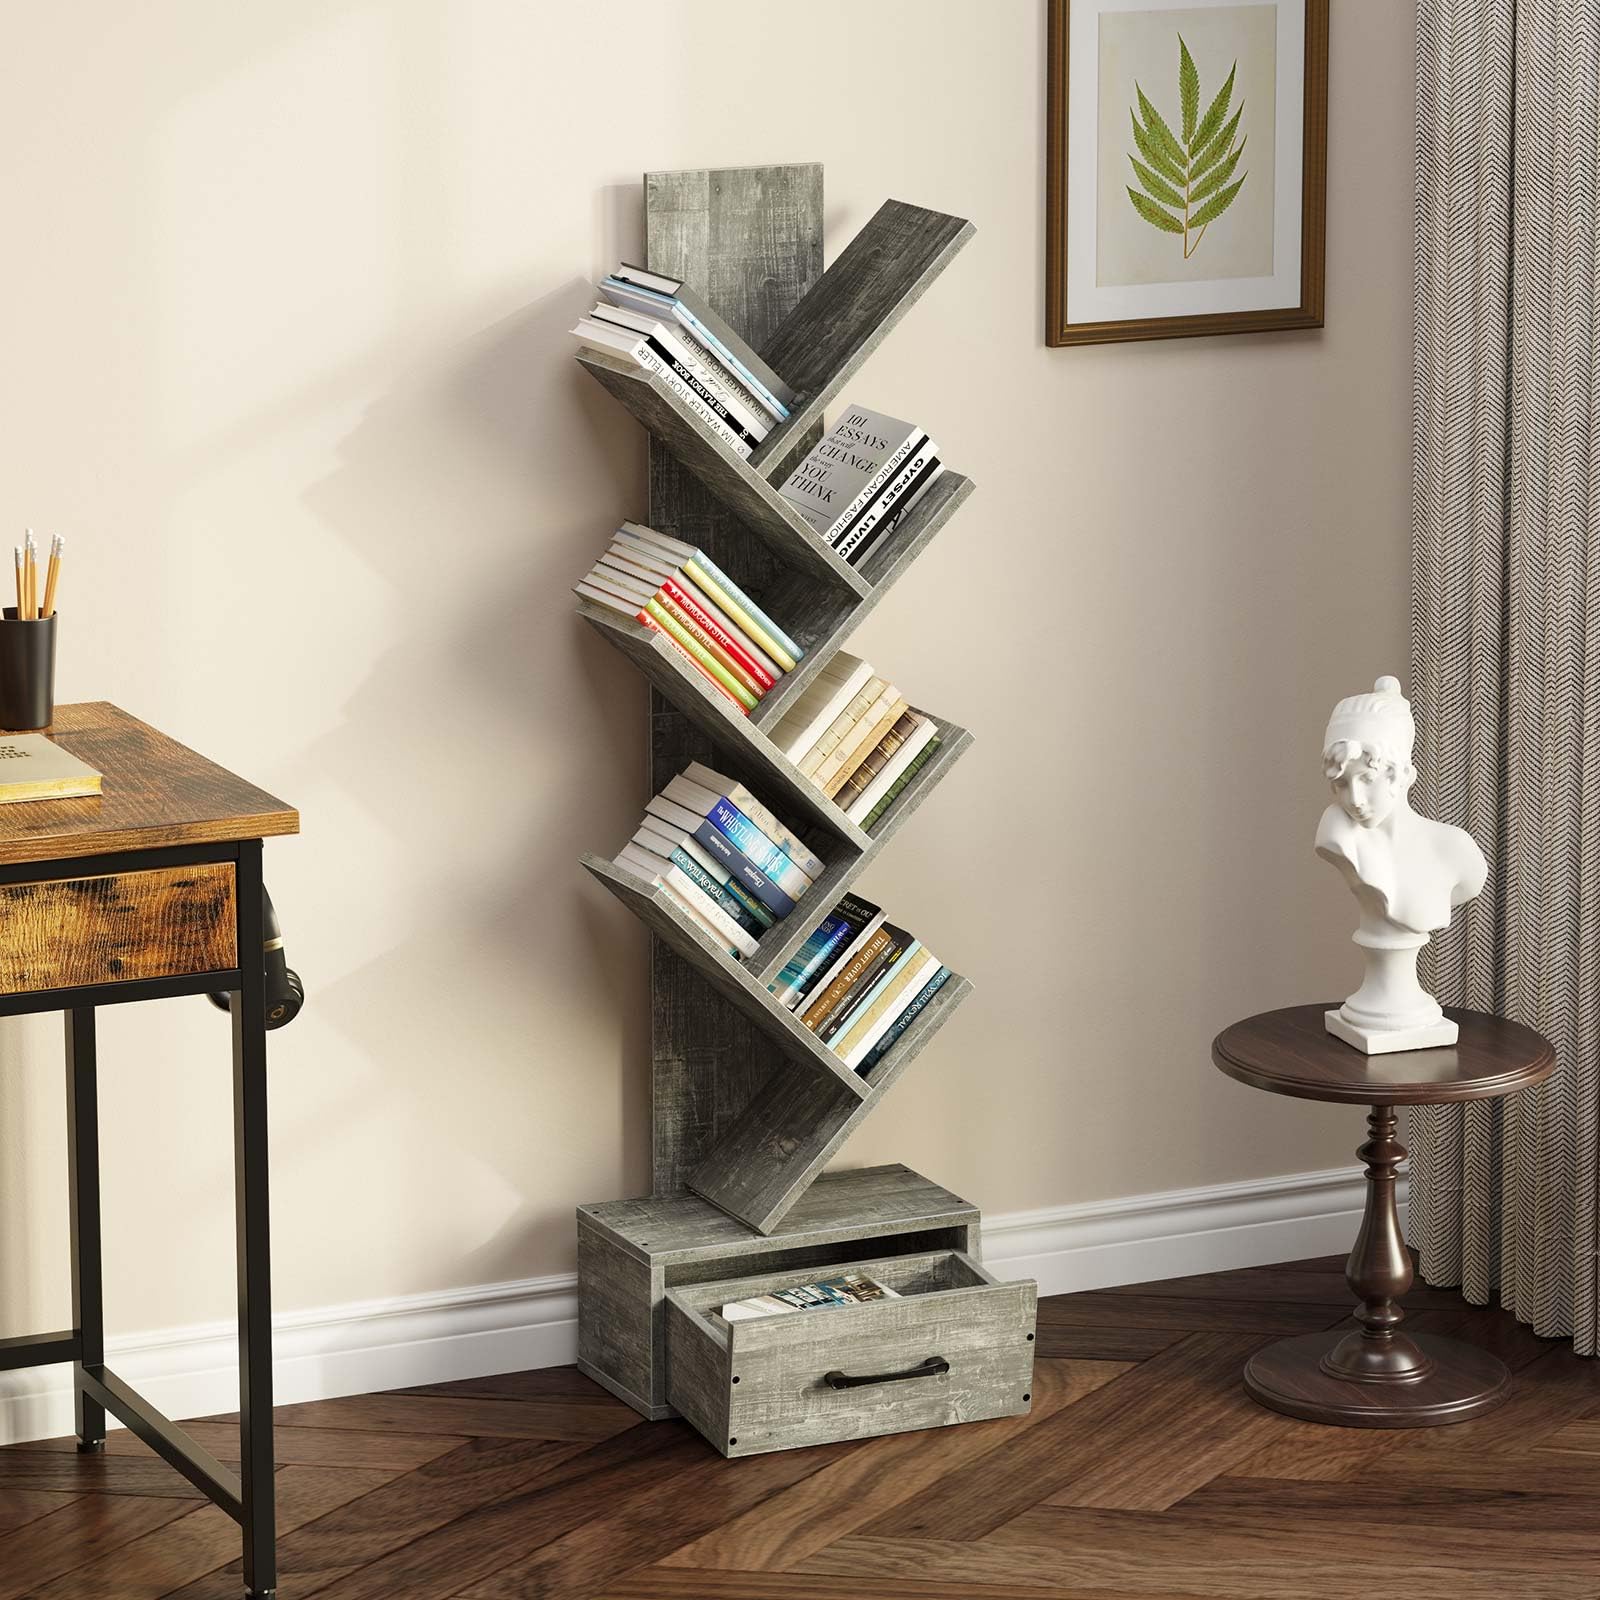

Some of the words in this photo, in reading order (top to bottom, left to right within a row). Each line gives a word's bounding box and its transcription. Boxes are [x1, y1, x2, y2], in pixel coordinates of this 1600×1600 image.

[680, 332, 704, 357] TELLER
[635, 346, 665, 374] TELLER
[670, 360, 690, 379] BOOK
[702, 353, 726, 379] STORY
[661, 373, 690, 400] STORY
[687, 376, 716, 405] PLAYBOY
[723, 374, 752, 405] WALKER
[687, 397, 722, 431] WALKER
[713, 402, 728, 417] THE
[750, 400, 764, 417] TIM
[847, 414, 868, 427] 101
[719, 429, 736, 445] TIM
[836, 426, 888, 450] ESSAYS
[819, 444, 877, 474] CHANGE
[862, 439, 912, 499] AMERICAN
[801, 463, 832, 482] YOU
[879, 456, 925, 509] GYPSET
[790, 475, 837, 502] THINK
[823, 497, 863, 544] FASHION
[837, 514, 876, 558] LIVING
[670, 606, 697, 632] AFRICAN
[694, 629, 713, 648] STYLE
[679, 596, 715, 630] MOROCCAN
[710, 626, 731, 646] STYLE
[688, 642, 707, 660] STYLE
[870, 935, 884, 950] THE
[858, 947, 874, 965] GIFT
[844, 961, 862, 982] GIVER
